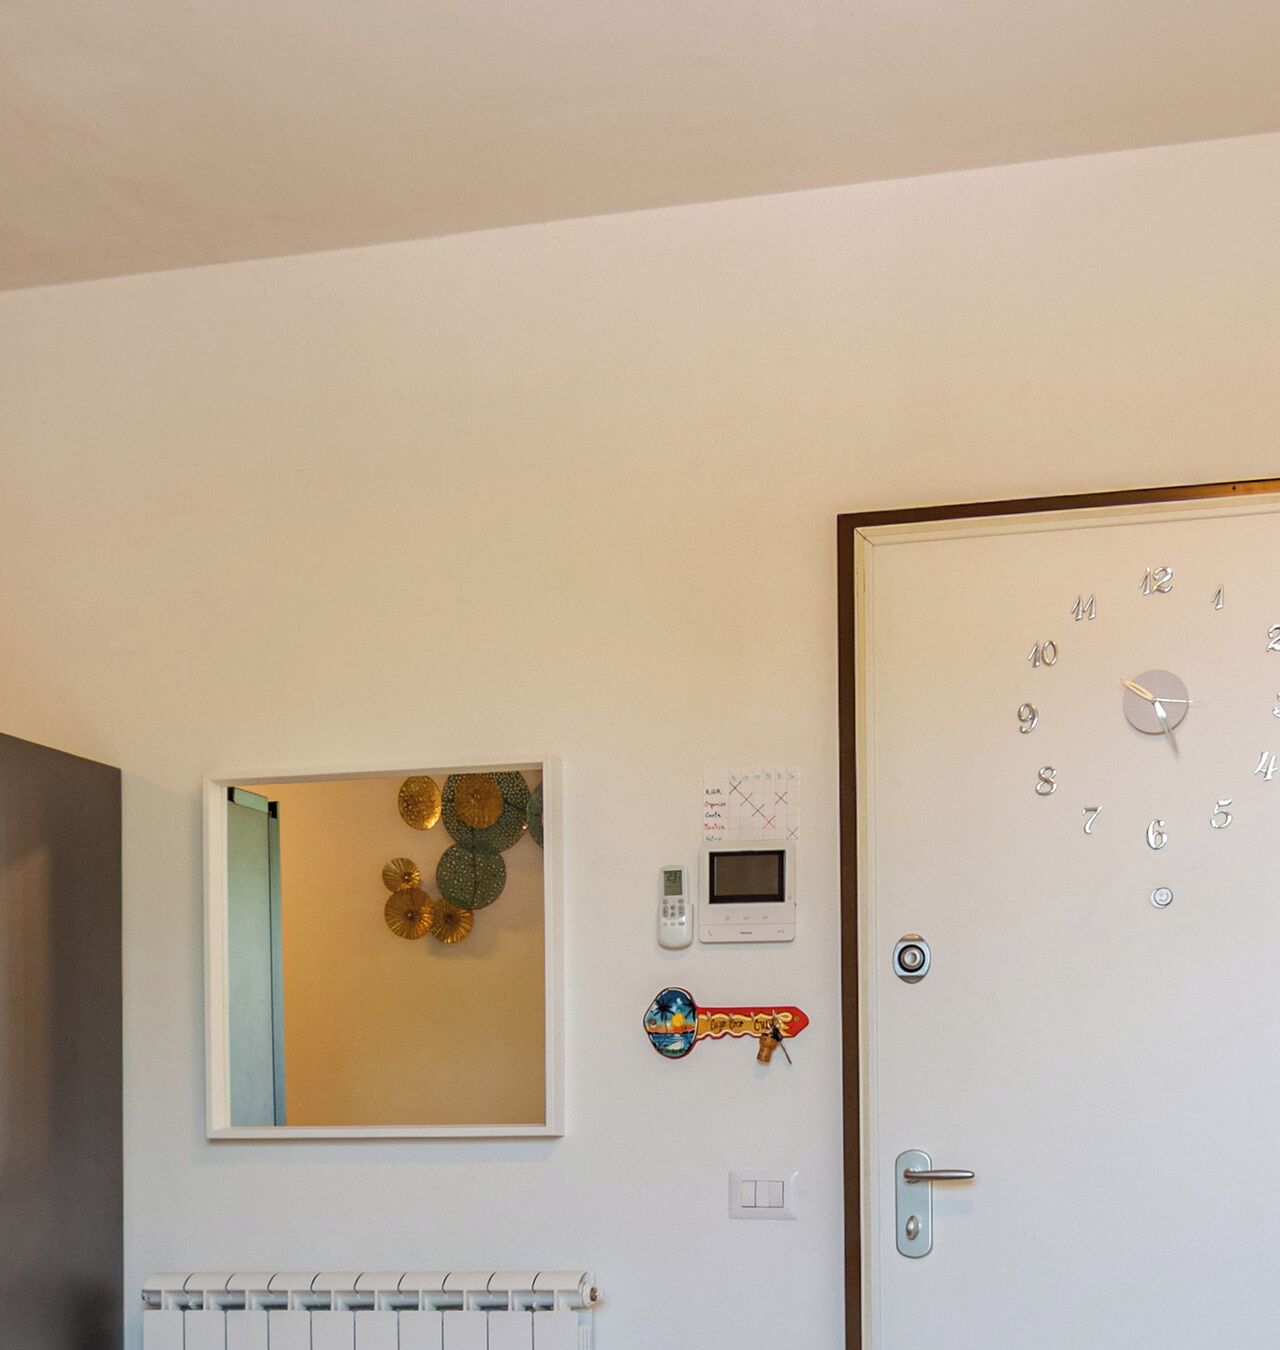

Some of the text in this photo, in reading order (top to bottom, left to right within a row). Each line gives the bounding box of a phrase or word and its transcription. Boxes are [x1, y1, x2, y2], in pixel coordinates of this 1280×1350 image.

[1138, 566, 1174, 596] 12
[1071, 593, 1097, 622] 11
[1210, 583, 1225, 611] 1
[1028, 640, 1058, 669] 10
[1017, 702, 1039, 734] 9
[1035, 766, 1058, 796] 8
[1253, 751, 1278, 782] 4
[1082, 805, 1105, 835] 7
[1210, 798, 1233, 829] 5
[1146, 818, 1169, 850] 6
